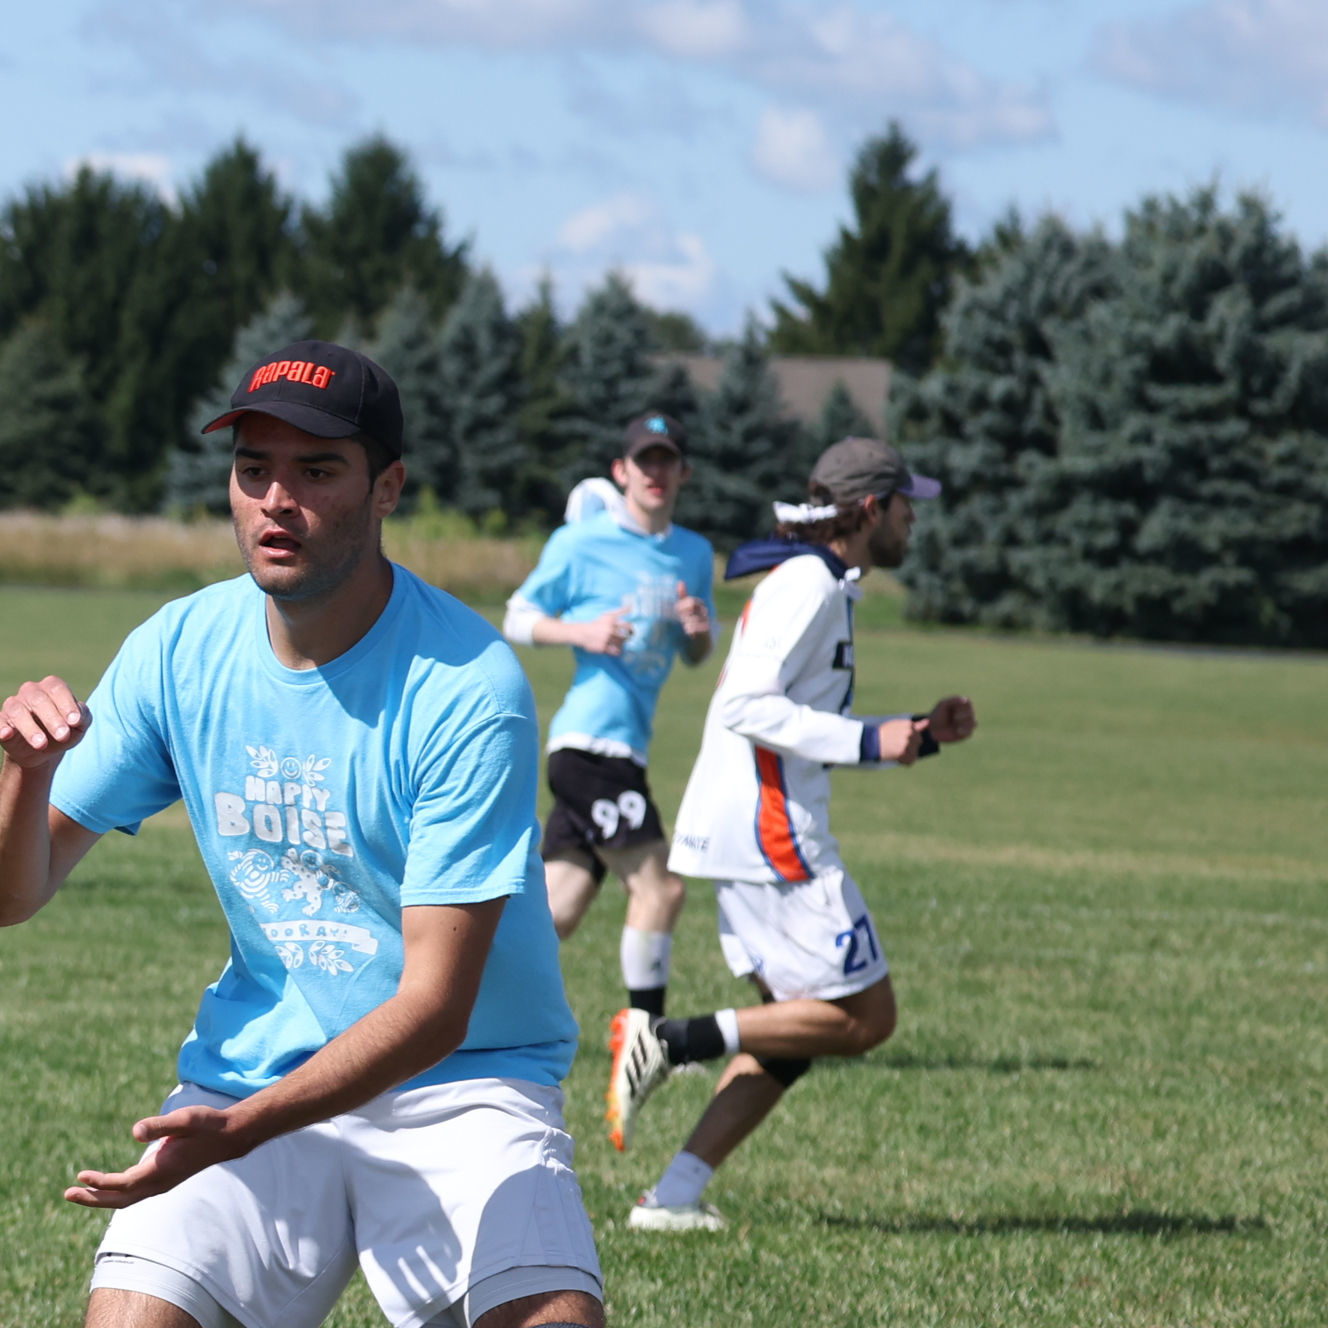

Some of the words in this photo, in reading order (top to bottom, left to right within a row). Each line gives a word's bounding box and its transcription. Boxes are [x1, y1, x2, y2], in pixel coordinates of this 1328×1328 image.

[245, 775, 331, 812] HAPPY
[591, 789, 647, 840] 99
[214, 792, 354, 857] BOISE
[835, 914, 879, 976] 27
